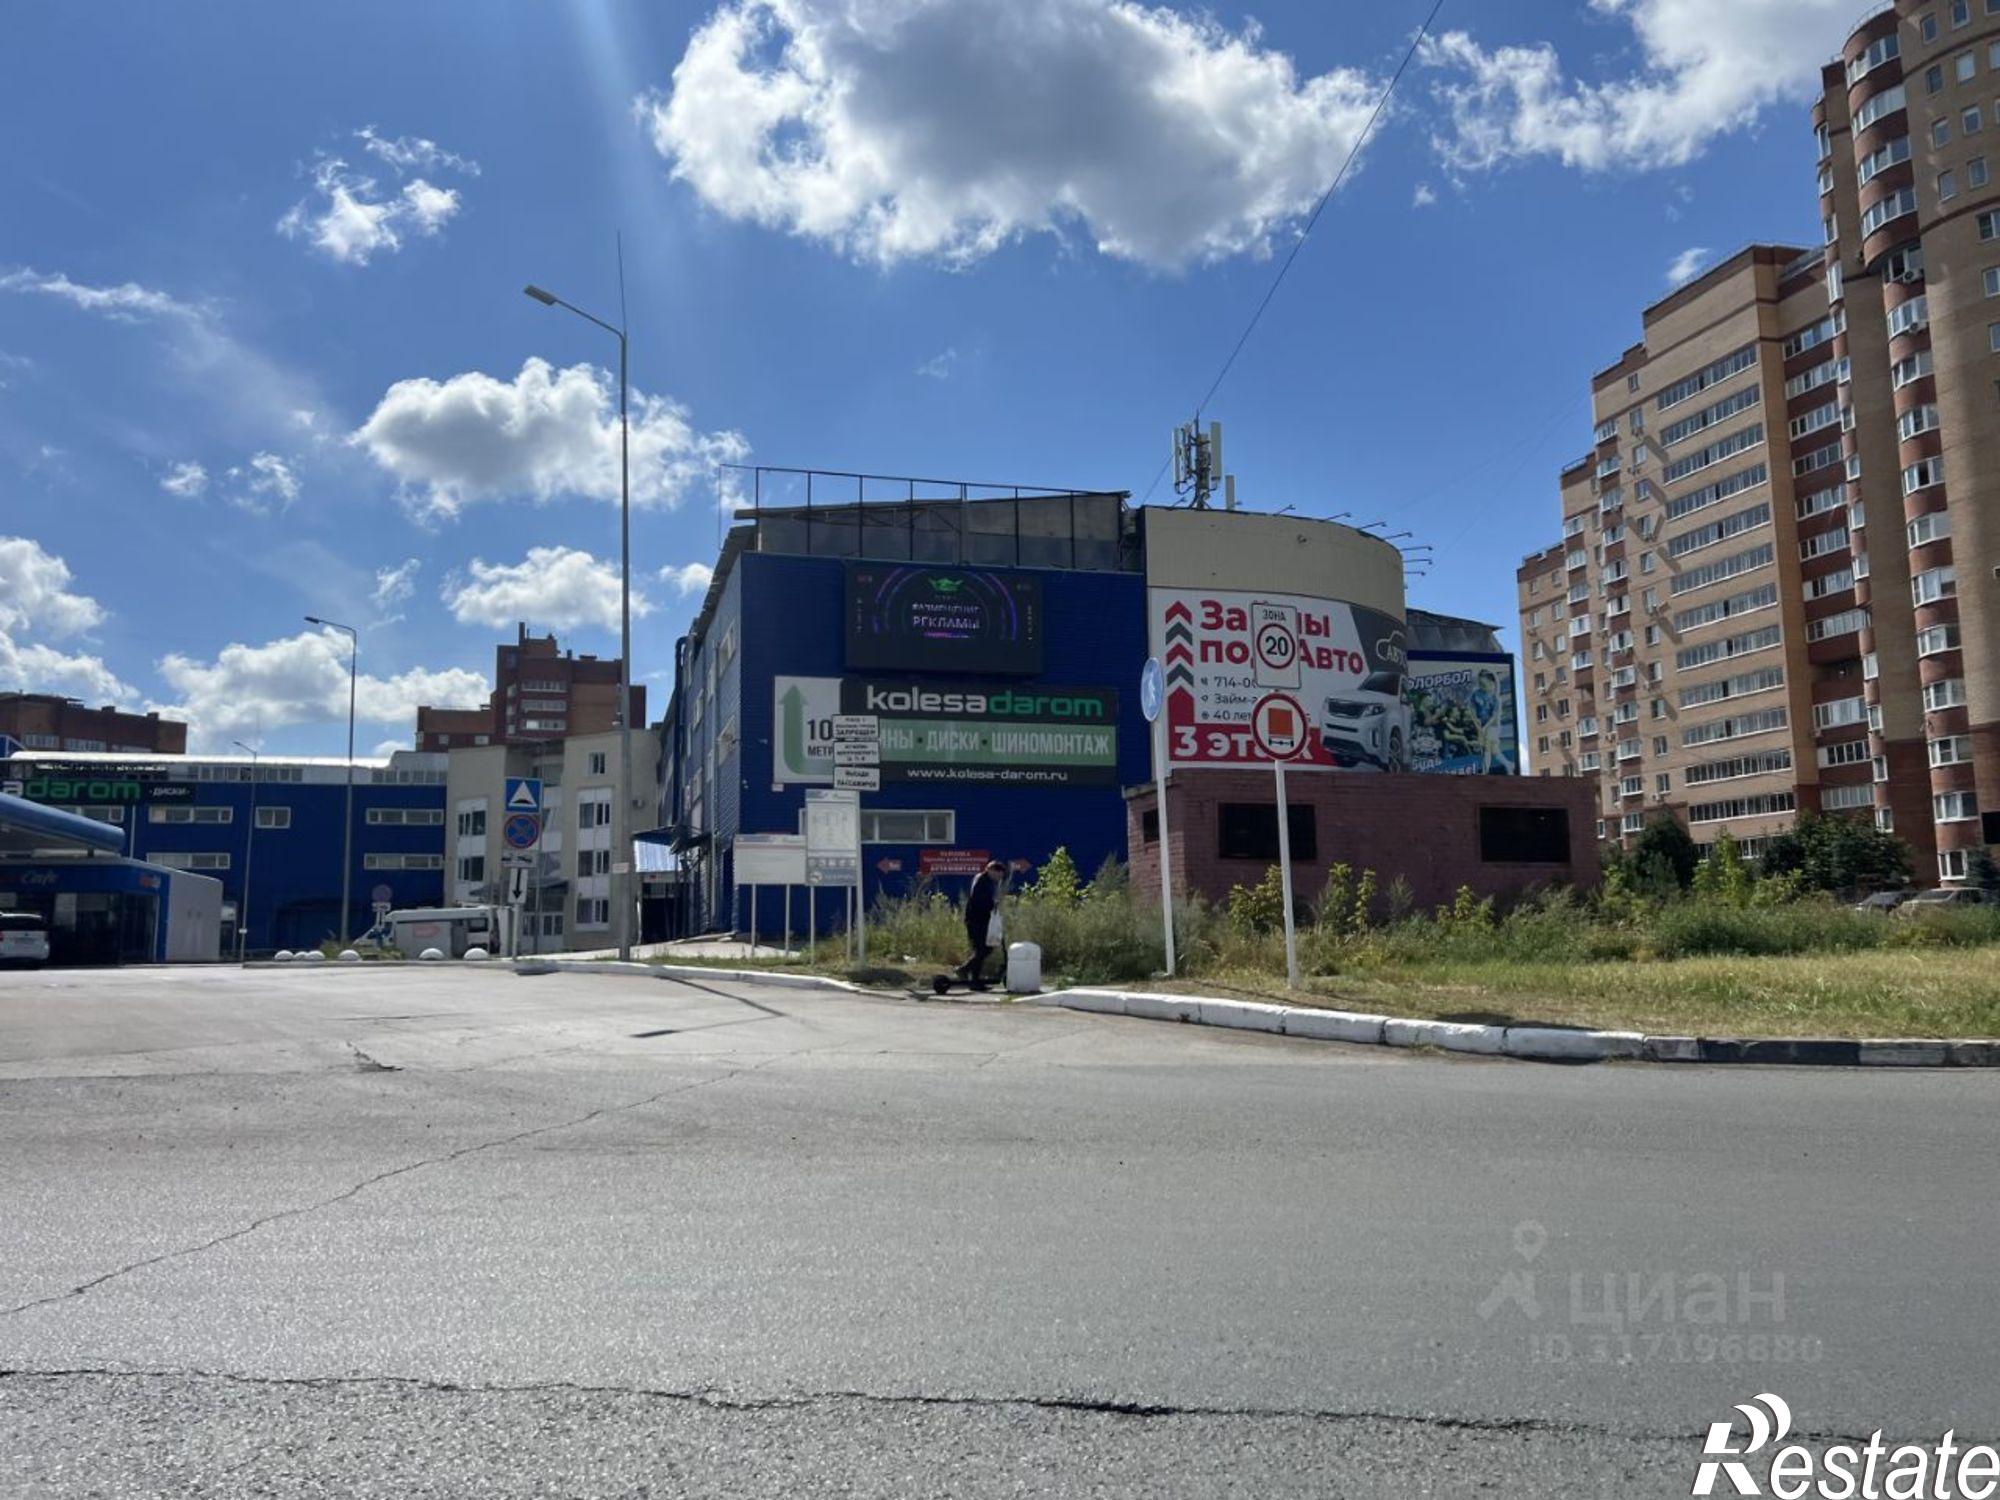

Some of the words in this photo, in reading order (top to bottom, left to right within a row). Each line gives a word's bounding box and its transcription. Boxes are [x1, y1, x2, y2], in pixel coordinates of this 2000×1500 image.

[1200, 600, 1330, 638] Заы
[1262, 608, 1287, 621] ЗОНА
[1200, 639, 1256, 671] по
[1265, 635, 1290, 657] 20
[867, 685, 1103, 717] kolesadarom
[1213, 710, 1231, 721] 40
[808, 745, 834, 758] МЕТР
[926, 730, 979, 753] ДИСКИ
[991, 732, 1110, 756] ШИНОМОНТАЖ
[1174, 725, 1199, 757] 3
[907, 767, 1068, 783] www.kolesa-darom.ru
